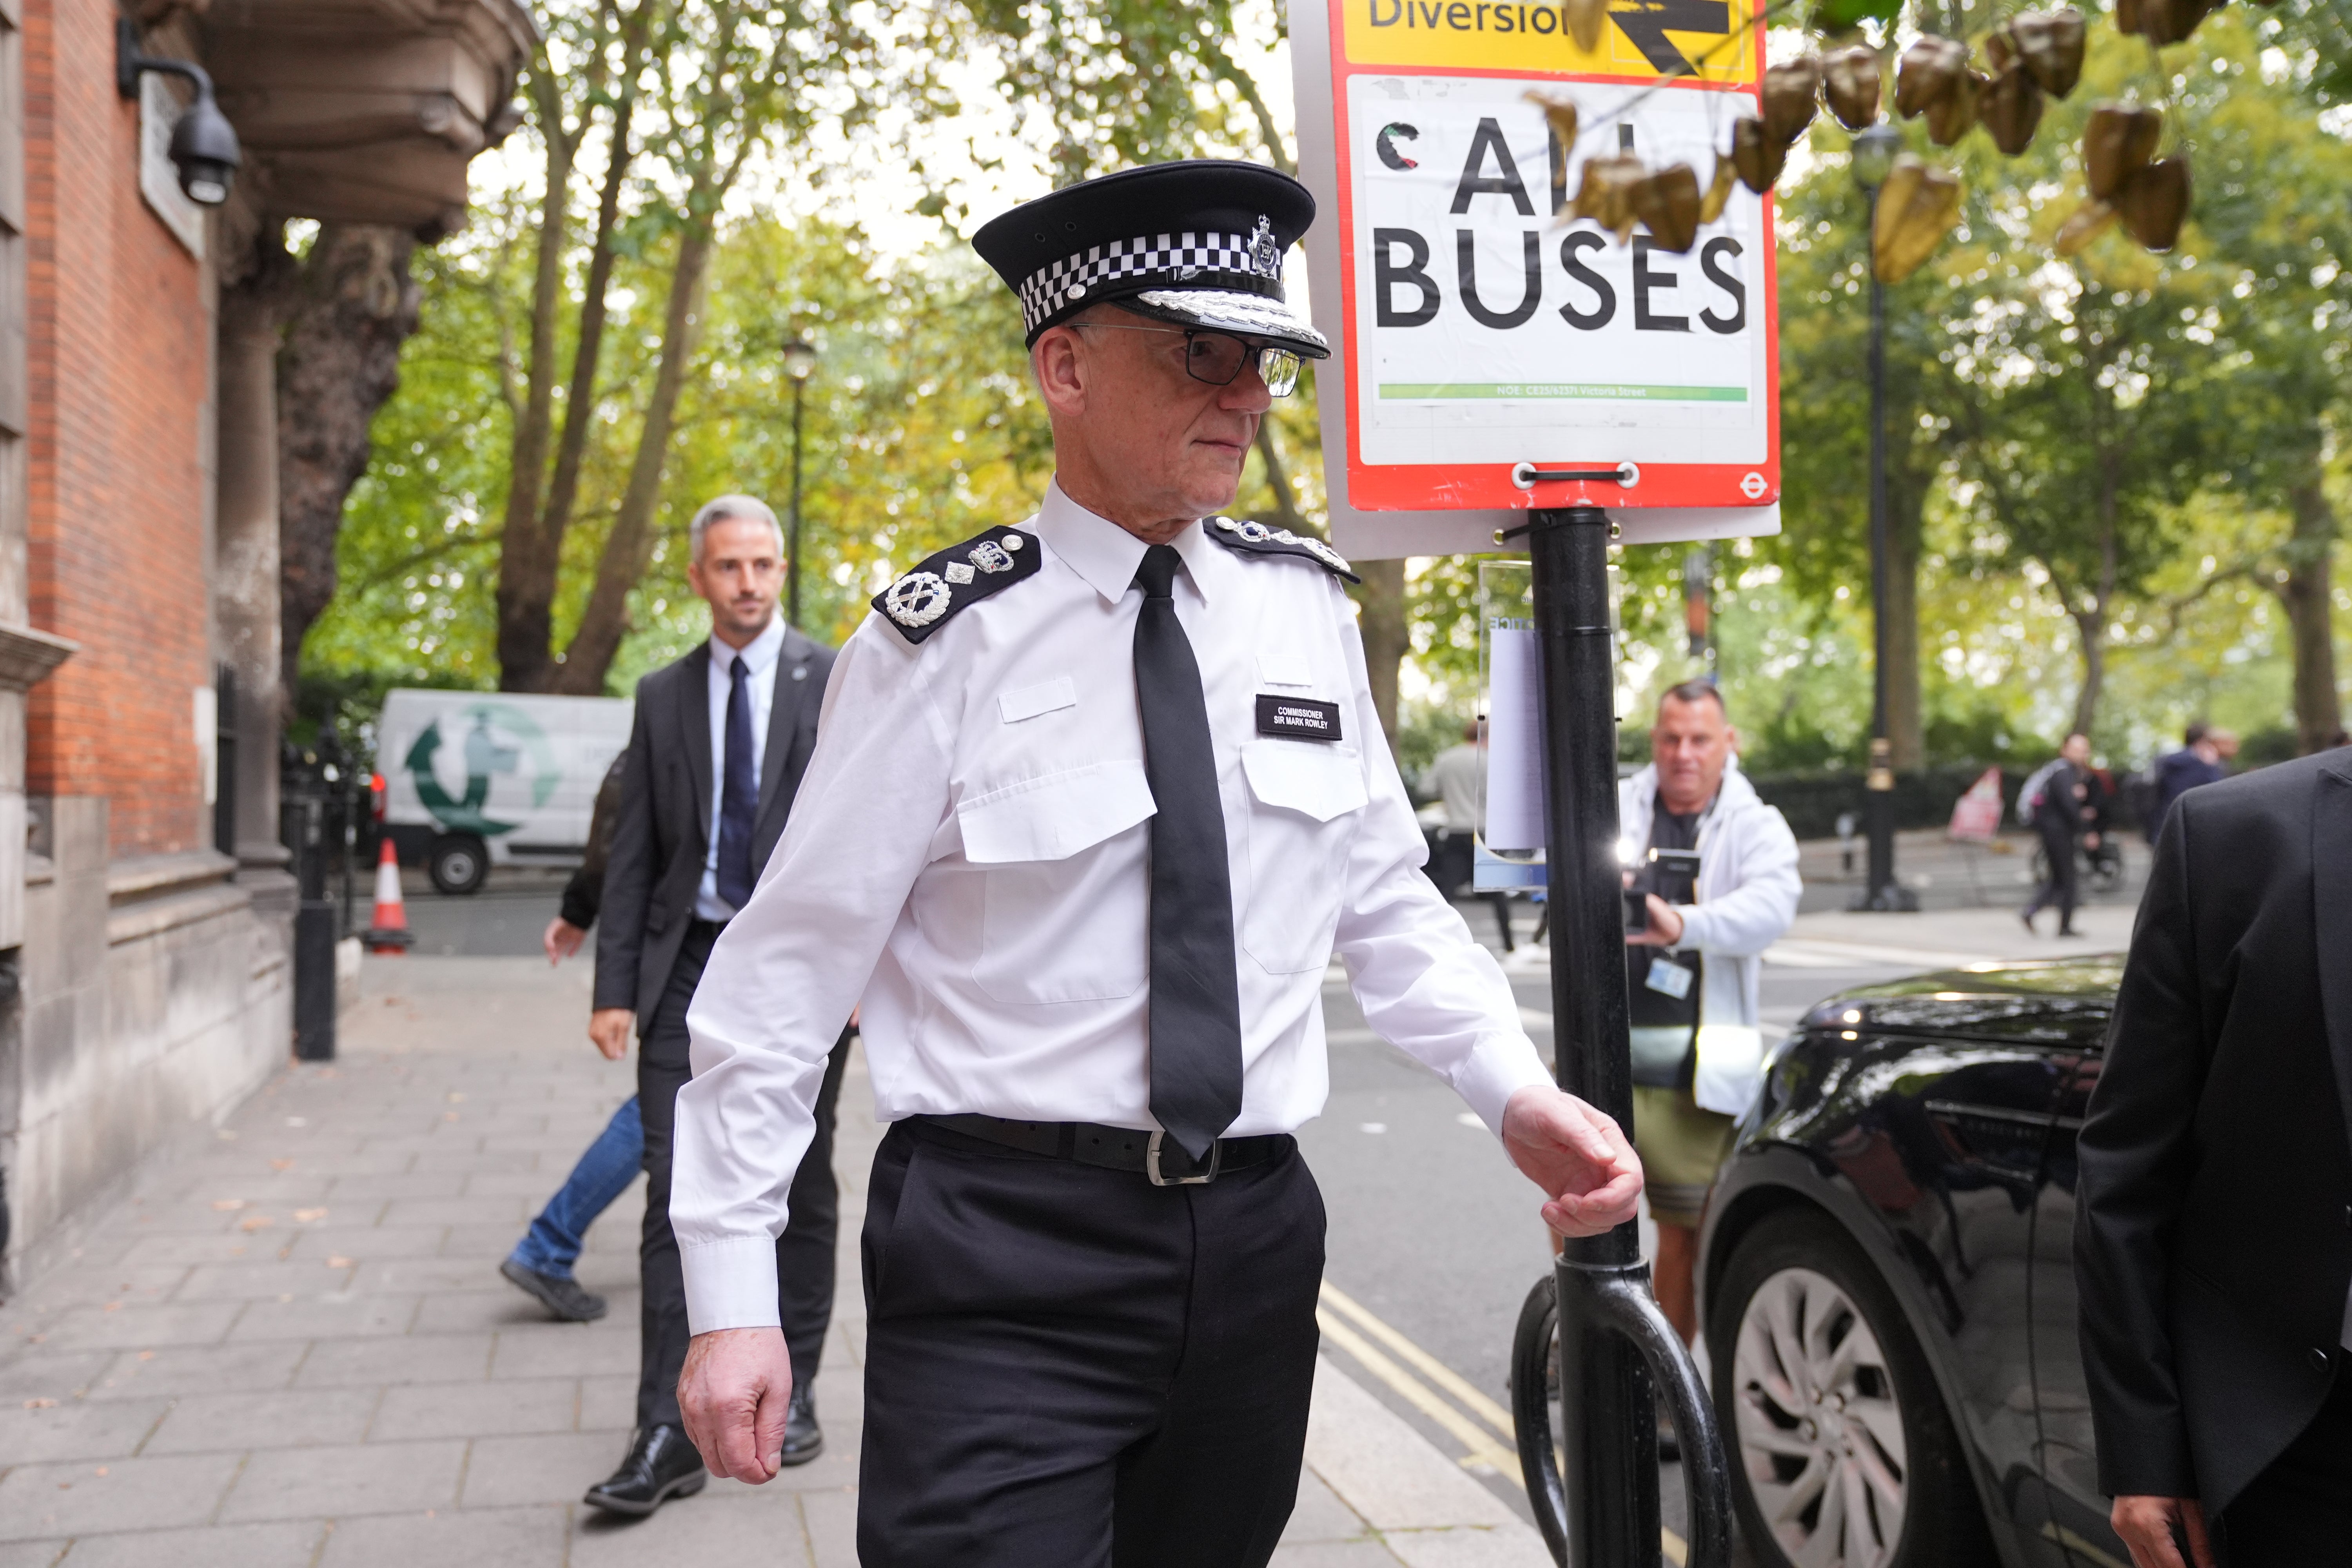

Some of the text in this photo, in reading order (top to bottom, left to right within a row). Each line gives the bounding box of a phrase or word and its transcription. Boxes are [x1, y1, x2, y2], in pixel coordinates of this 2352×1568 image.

[1370, 0, 1568, 35] Diversio
[1374, 228, 1746, 334] BUSES
[1497, 386, 1522, 395] NOE:
[1580, 387, 1616, 396] Victoria
[1618, 387, 1646, 397] Street
[1278, 706, 1323, 719] COMMISSIONER
[1274, 715, 1328, 730] SIR MARK ROWLEY
